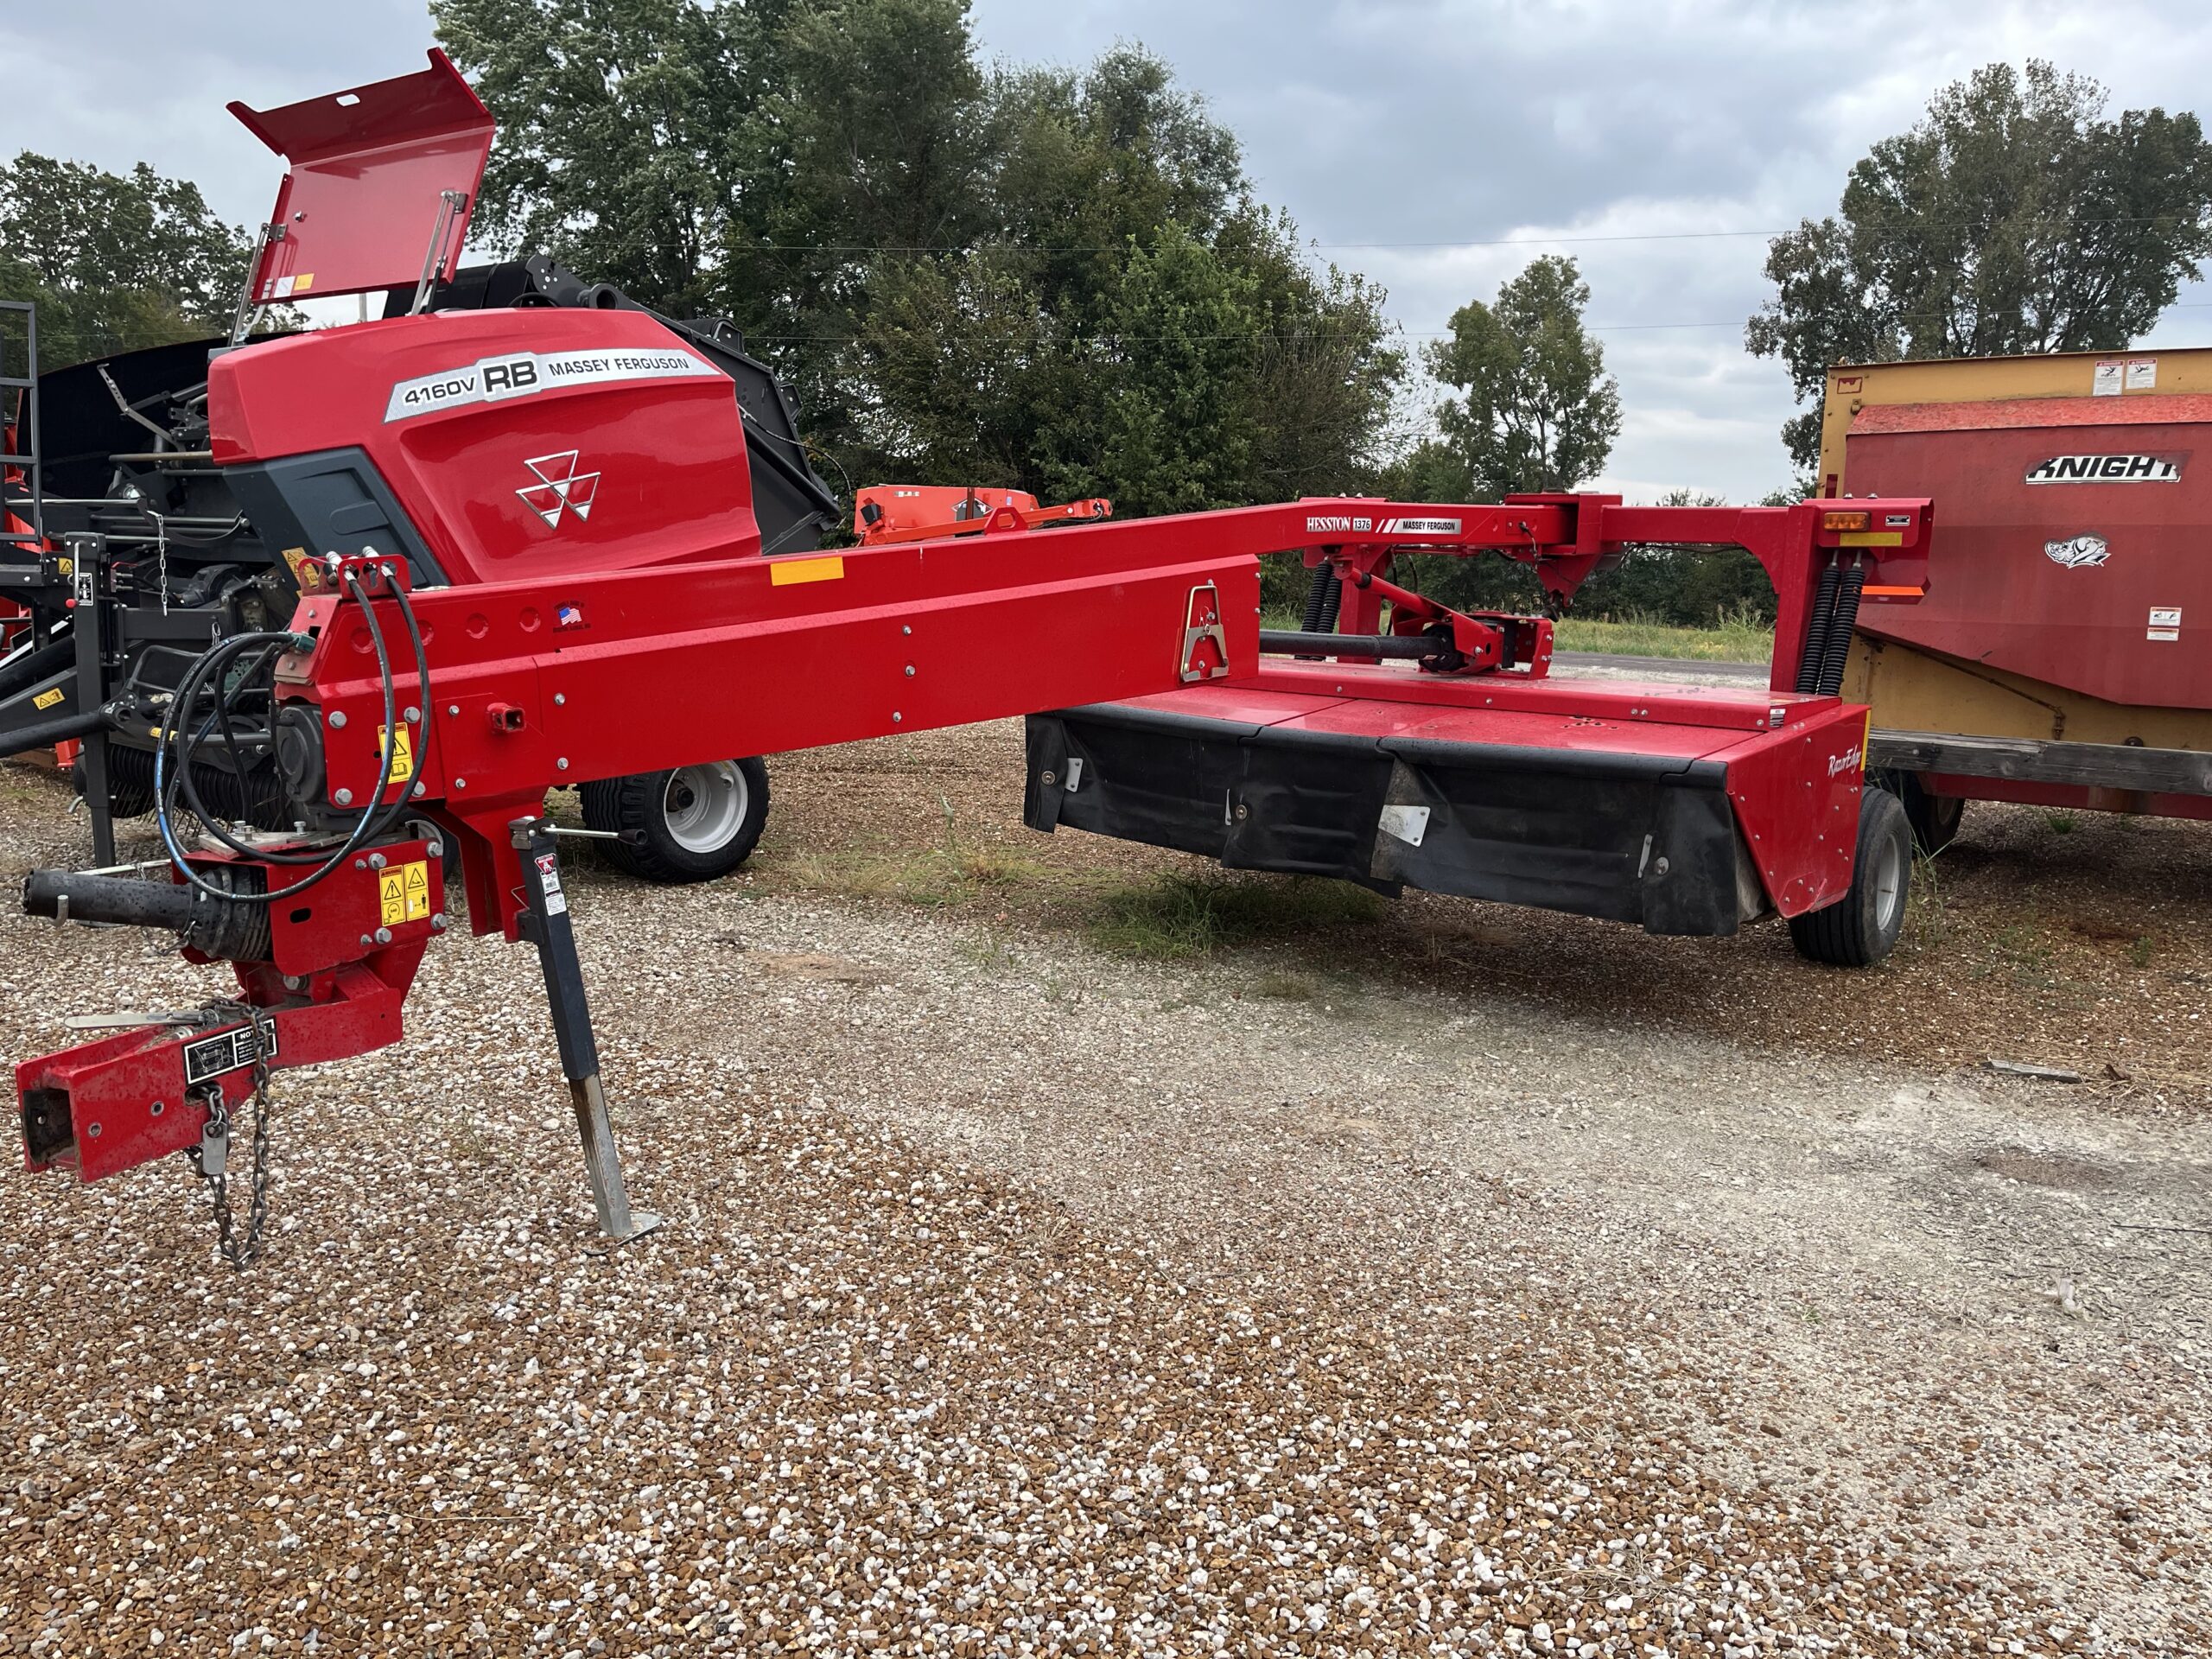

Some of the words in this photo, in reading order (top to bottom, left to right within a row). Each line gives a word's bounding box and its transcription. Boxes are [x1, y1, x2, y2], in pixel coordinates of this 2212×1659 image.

[404, 378, 476, 404] 4160V
[482, 360, 537, 392] RB
[549, 359, 611, 376] MASSEY
[616, 358, 690, 370] FERGUSON
[1306, 517, 1351, 532] HESSTON
[1354, 520, 1370, 530] 1376
[1402, 520, 1426, 530] MASSEY
[1427, 521, 1455, 531] FERGUSON
